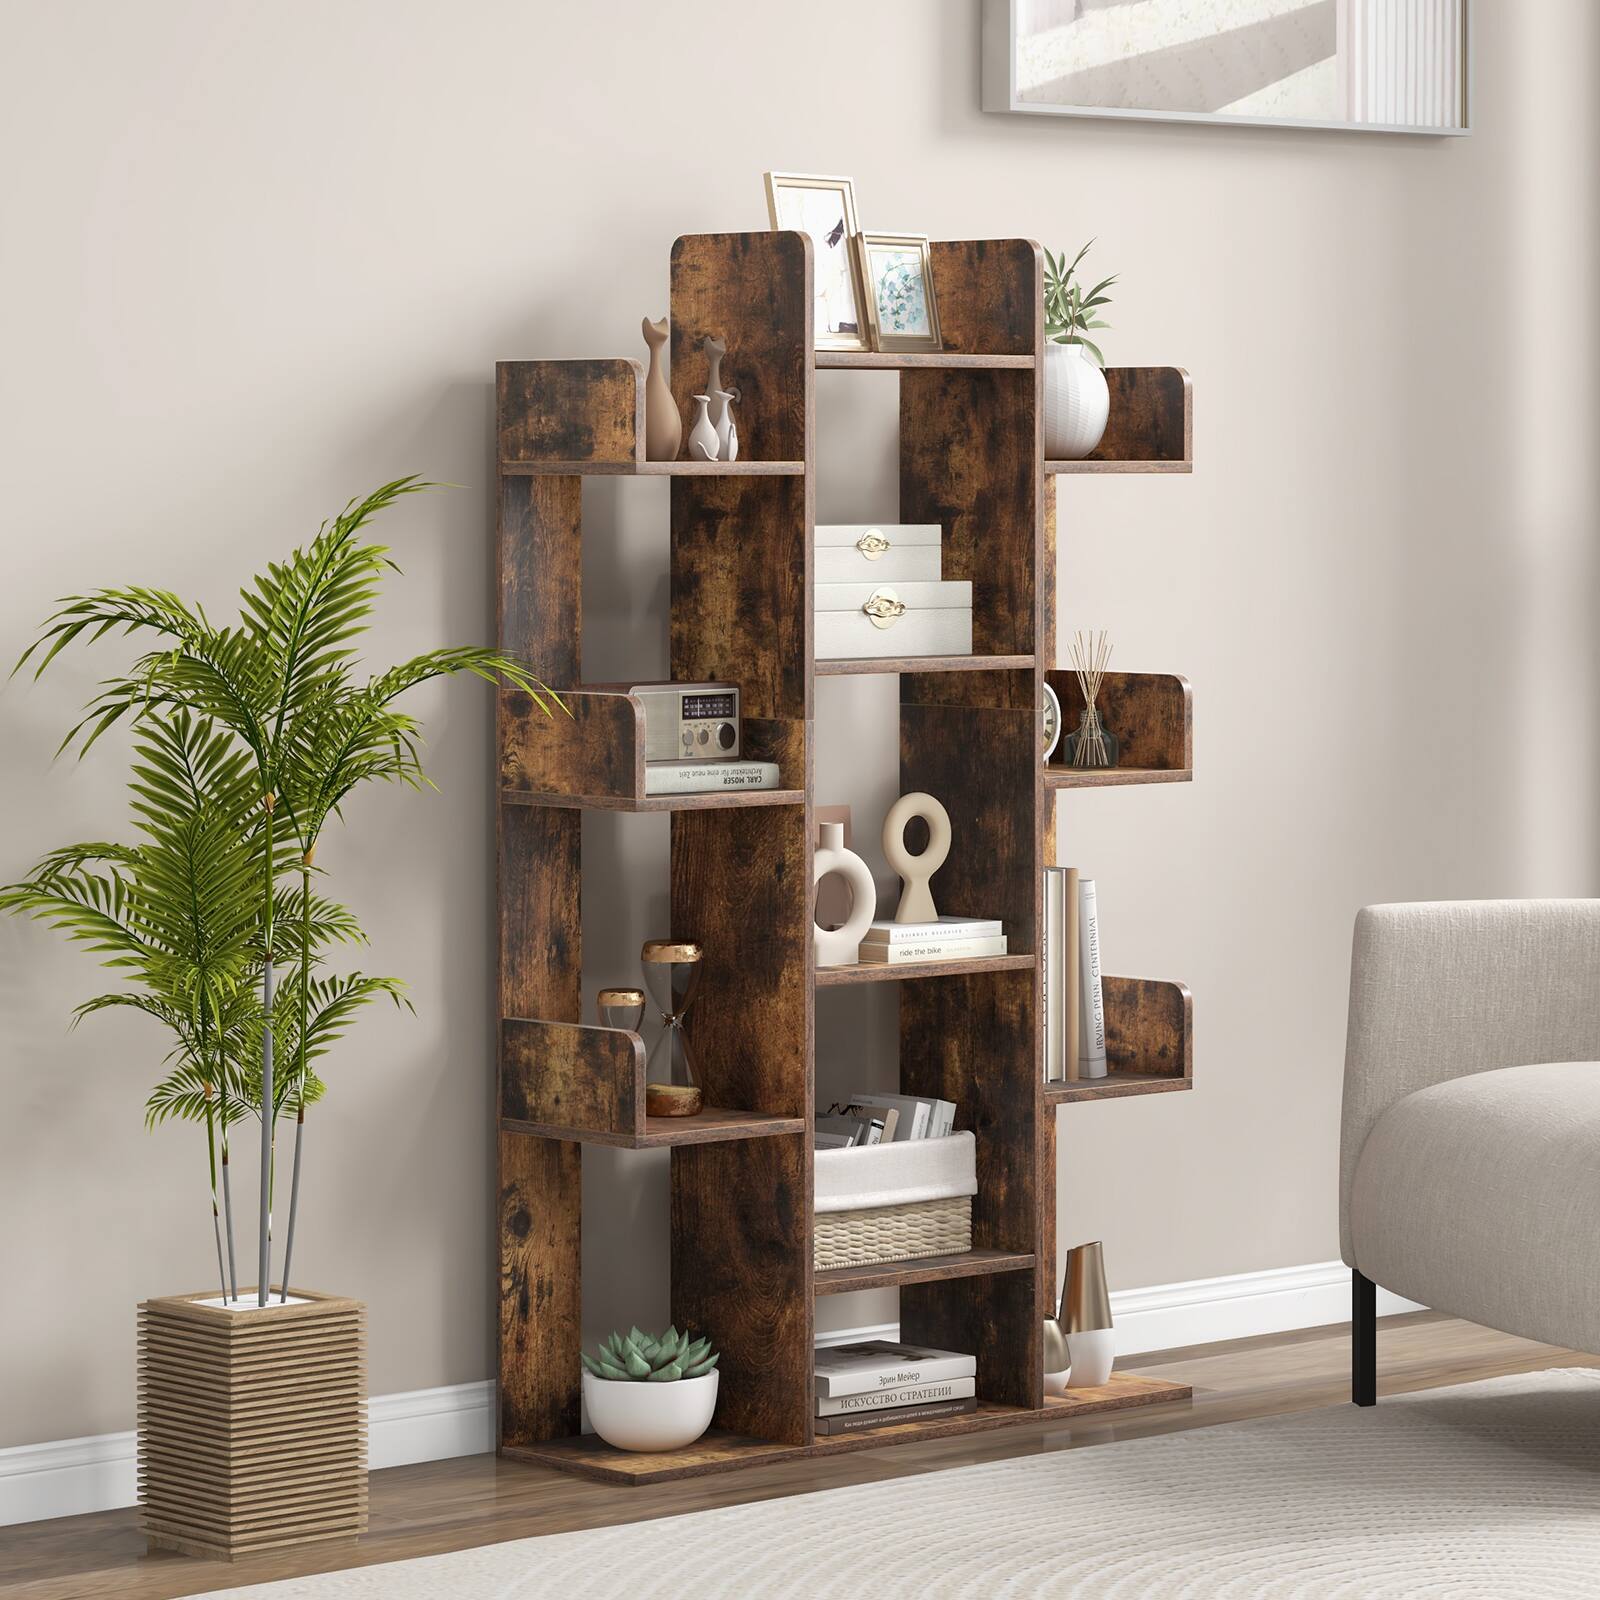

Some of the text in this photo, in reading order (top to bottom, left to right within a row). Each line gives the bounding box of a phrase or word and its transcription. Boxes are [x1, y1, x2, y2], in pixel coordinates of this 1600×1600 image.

[679, 771, 690, 779] Zeit
[731, 768, 762, 776] Architektur
[724, 776, 762, 784] CARL MOSER
[899, 948, 912, 957] ride
[914, 947, 926, 956] the
[927, 946, 942, 954] bike
[1089, 916, 1100, 978] CENTENNIAL
[1094, 1013, 1104, 1050] IRVING
[878, 1371, 920, 1386] Эрин Мейер
[840, 1386, 952, 1409] ИСКУССТВО СТРАТЕГИИ
